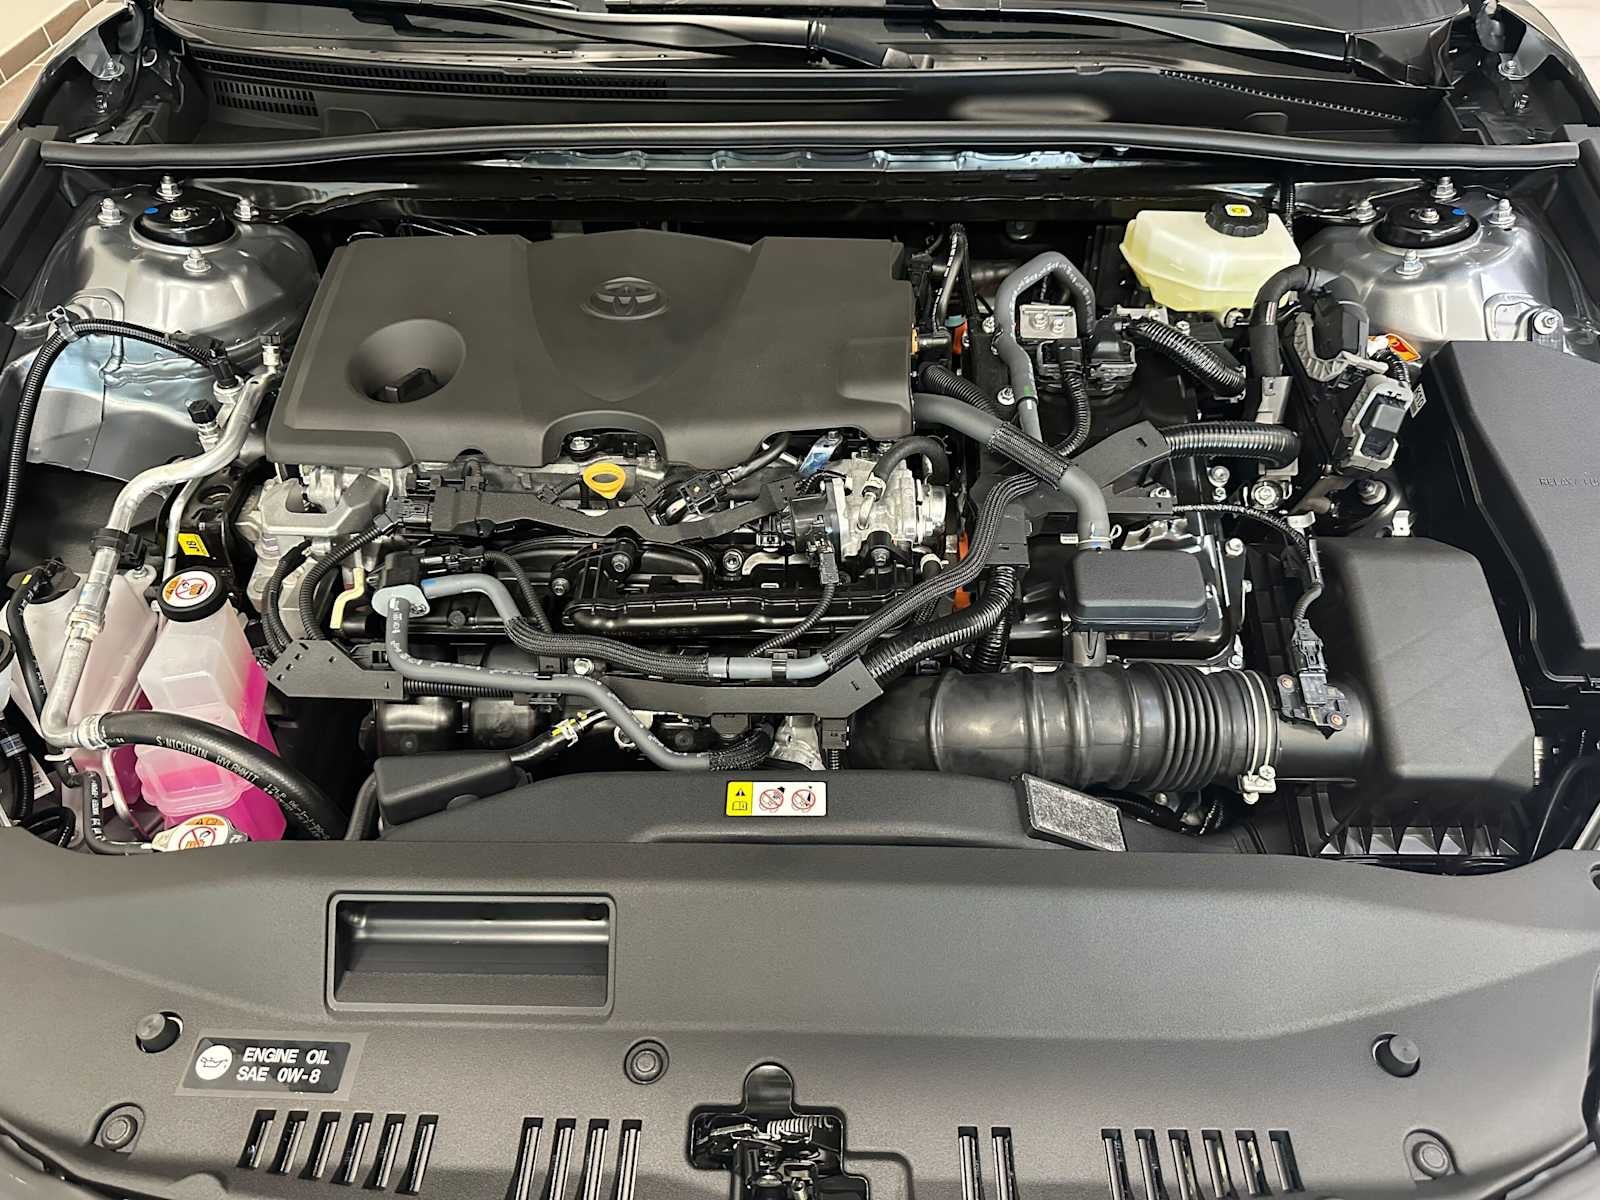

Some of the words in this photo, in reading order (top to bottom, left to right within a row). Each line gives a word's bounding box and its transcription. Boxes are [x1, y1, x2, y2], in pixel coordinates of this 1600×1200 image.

[242, 1047, 299, 1064] ENGINE
[305, 1049, 330, 1065] OIL
[236, 1066, 270, 1082] SAE
[276, 1067, 321, 1084] 0W-8
